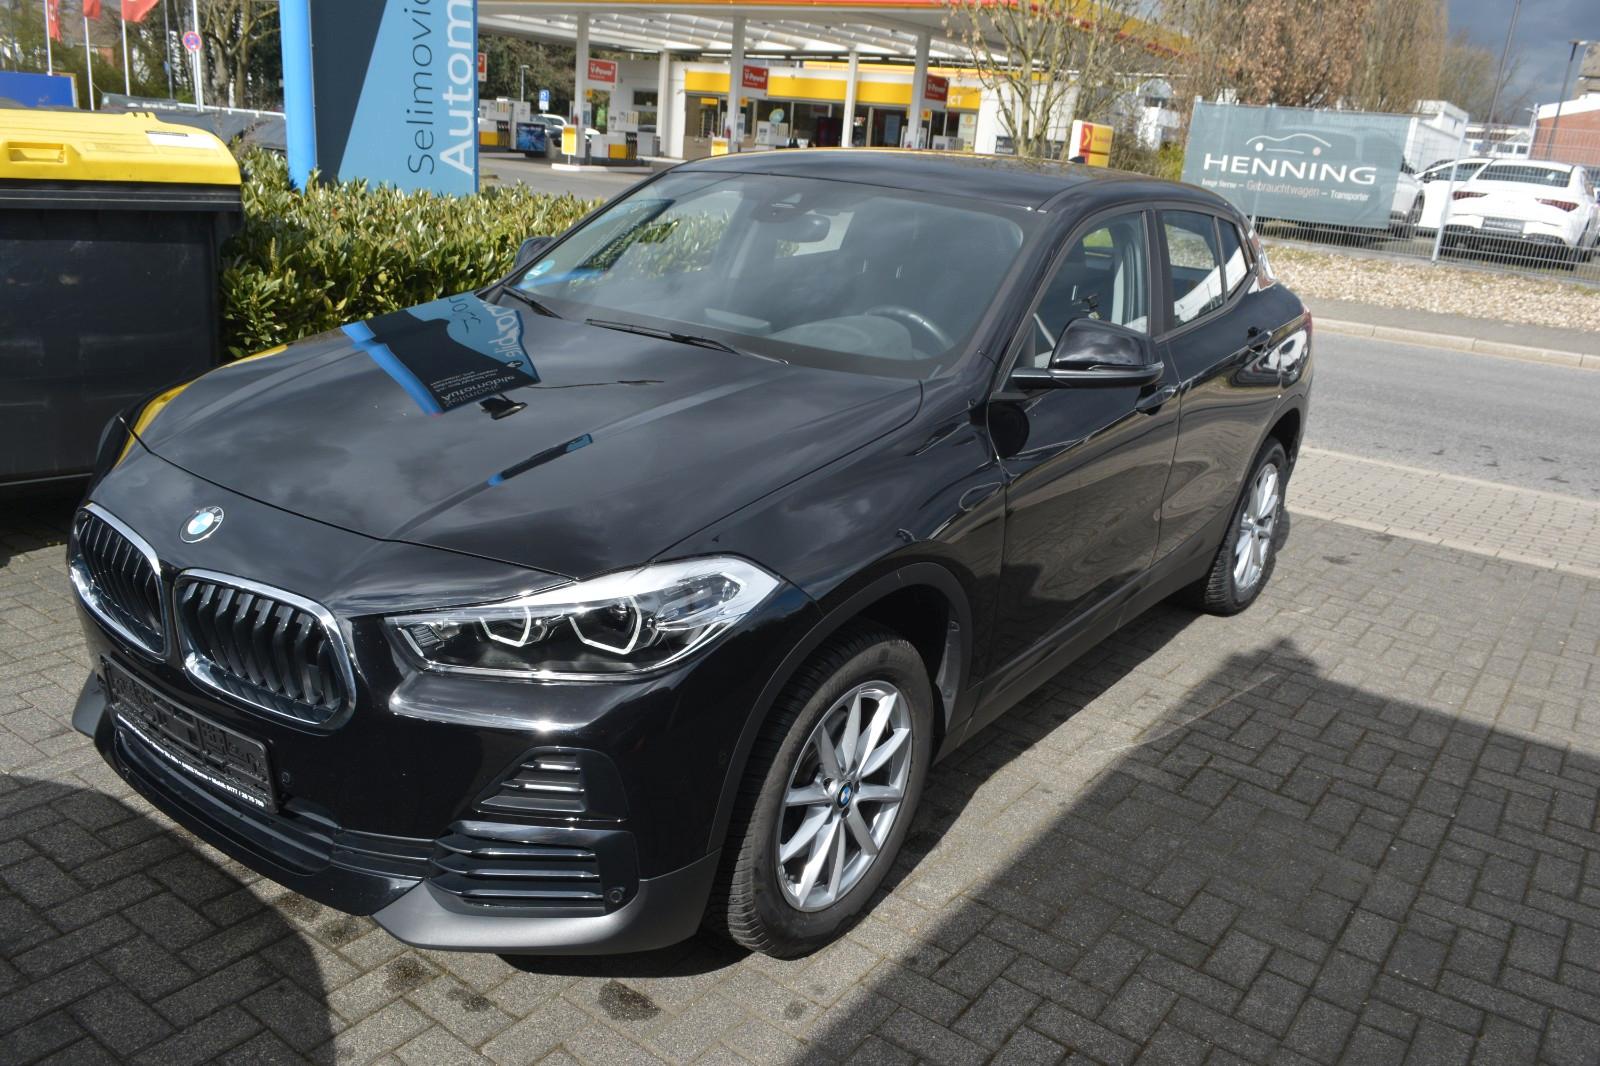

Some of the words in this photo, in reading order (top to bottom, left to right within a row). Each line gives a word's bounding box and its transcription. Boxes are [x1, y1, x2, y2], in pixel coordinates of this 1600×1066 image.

[404, 0, 435, 175] Selimovi
[1203, 153, 1377, 185] HENNING
[1246, 180, 1320, 199] Gebrauchtwagen
[1330, 189, 1370, 202] Transporter
